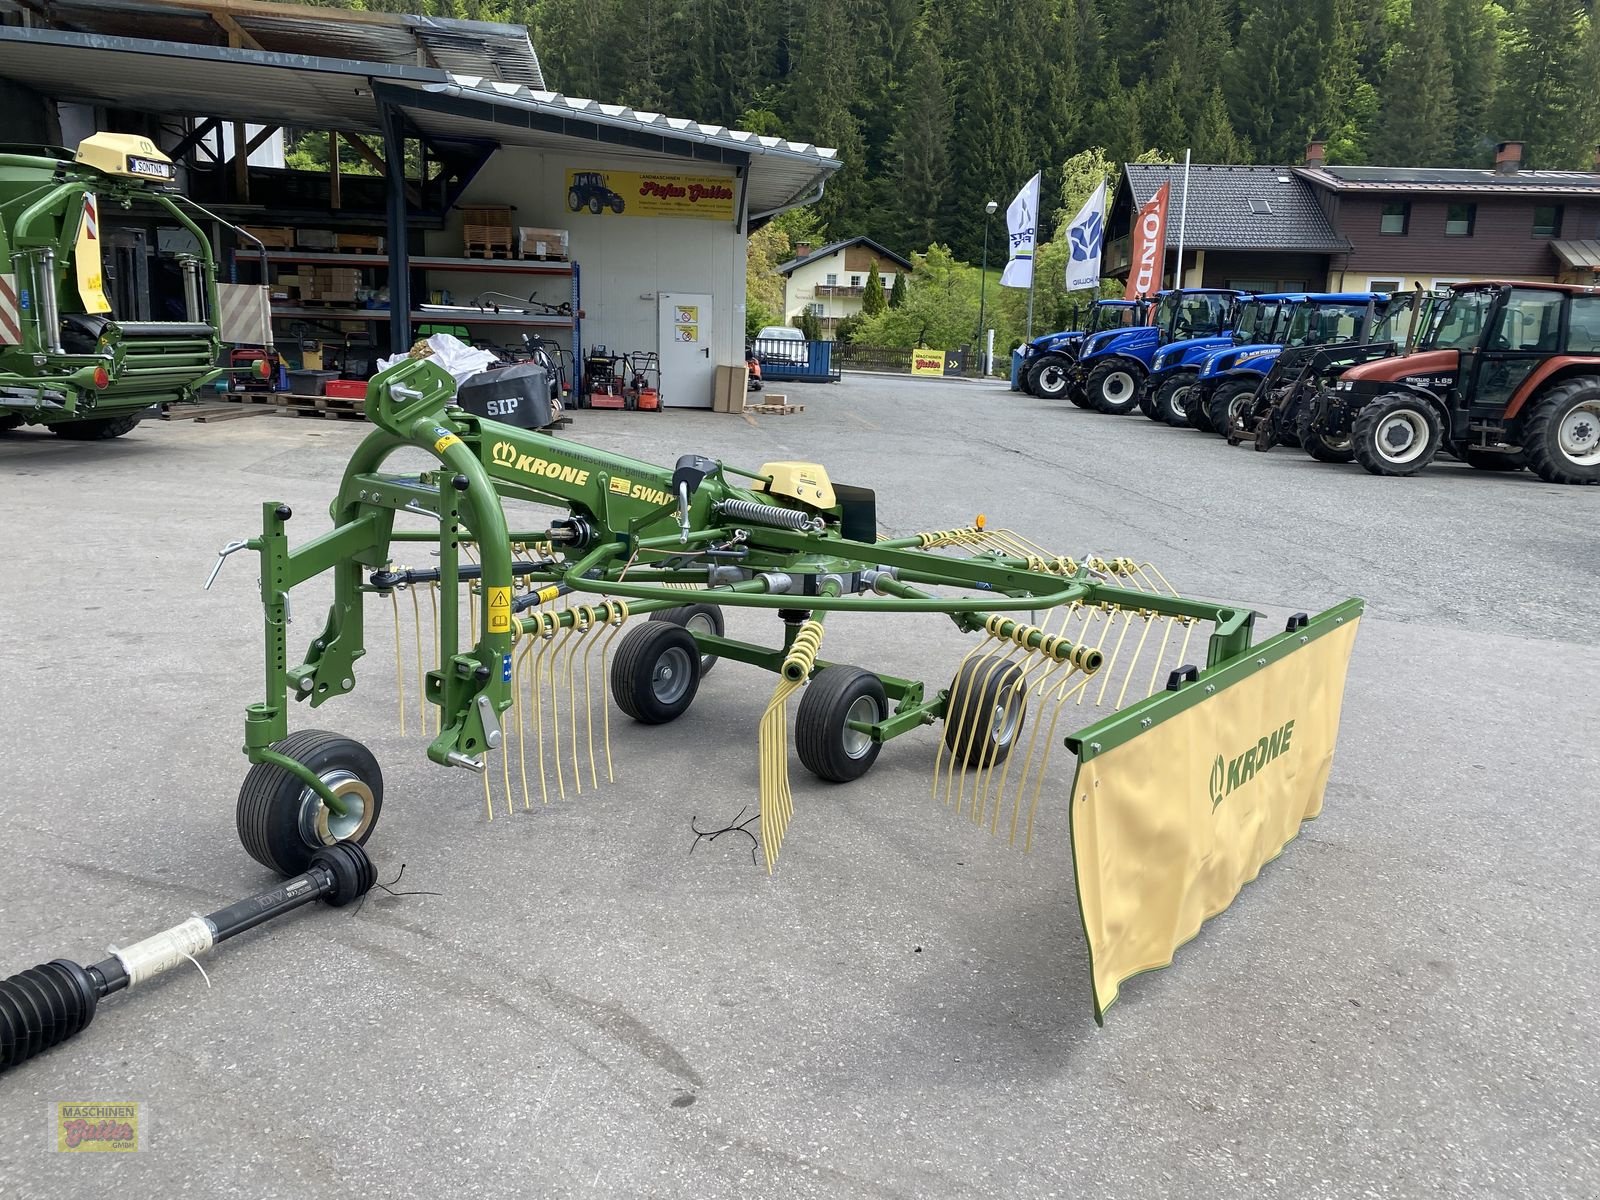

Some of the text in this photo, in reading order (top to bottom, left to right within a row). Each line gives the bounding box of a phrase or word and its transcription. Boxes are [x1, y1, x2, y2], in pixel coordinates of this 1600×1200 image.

[639, 181, 686, 200] Stefan
[1136, 188, 1160, 297] OND
[486, 398, 518, 416] SIP
[514, 454, 590, 486] KRONE
[549, 447, 658, 482] www.maschinen-gailer.at
[630, 484, 678, 506] SWAD
[1225, 719, 1295, 797] KRONE
